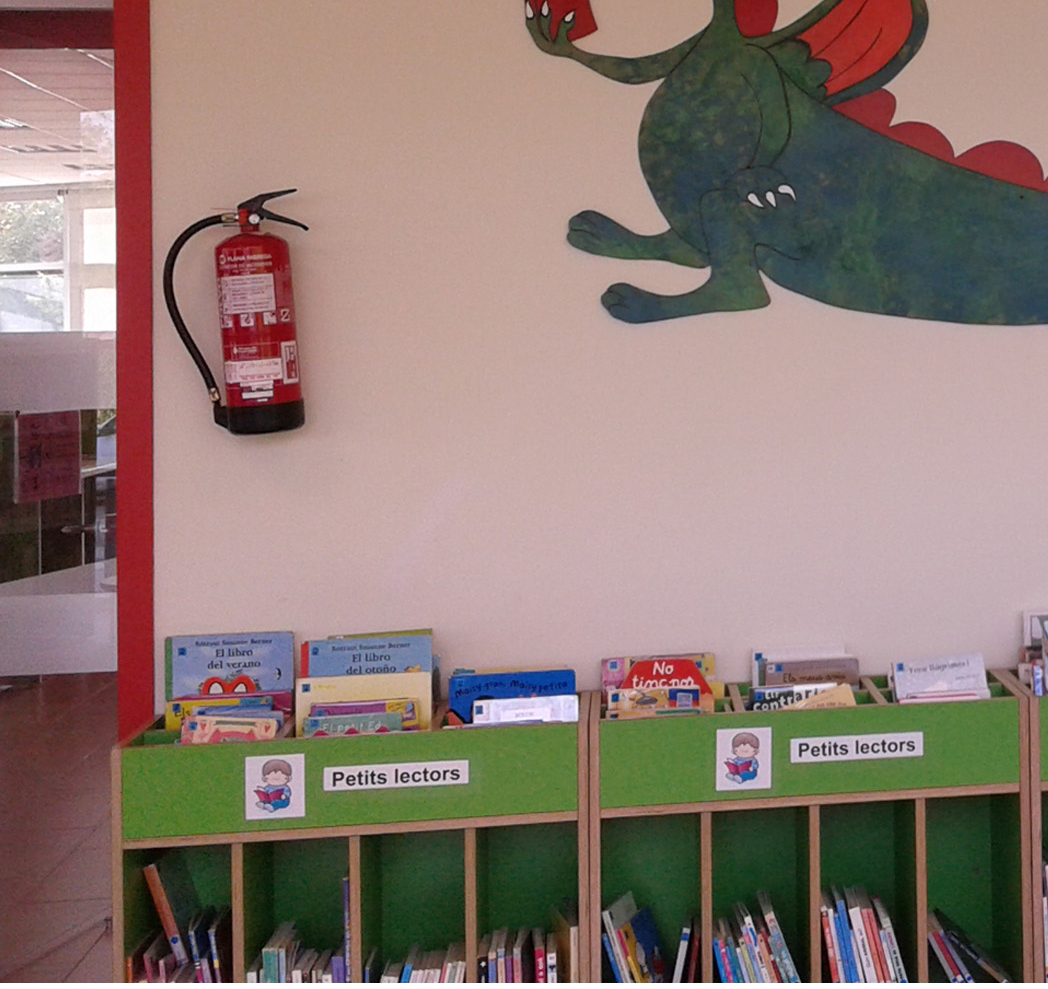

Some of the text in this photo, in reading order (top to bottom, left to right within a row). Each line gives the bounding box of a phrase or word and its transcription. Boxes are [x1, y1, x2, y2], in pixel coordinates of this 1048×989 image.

[215, 648, 253, 658] El libro
[352, 652, 391, 663] El libro
[207, 661, 261, 670] del verano
[346, 664, 396, 675] del otoño
[652, 661, 674, 676] No
[510, 679, 537, 692] Maisy
[798, 737, 916, 758] Petits lectors
[331, 766, 461, 788] Petits lectors
